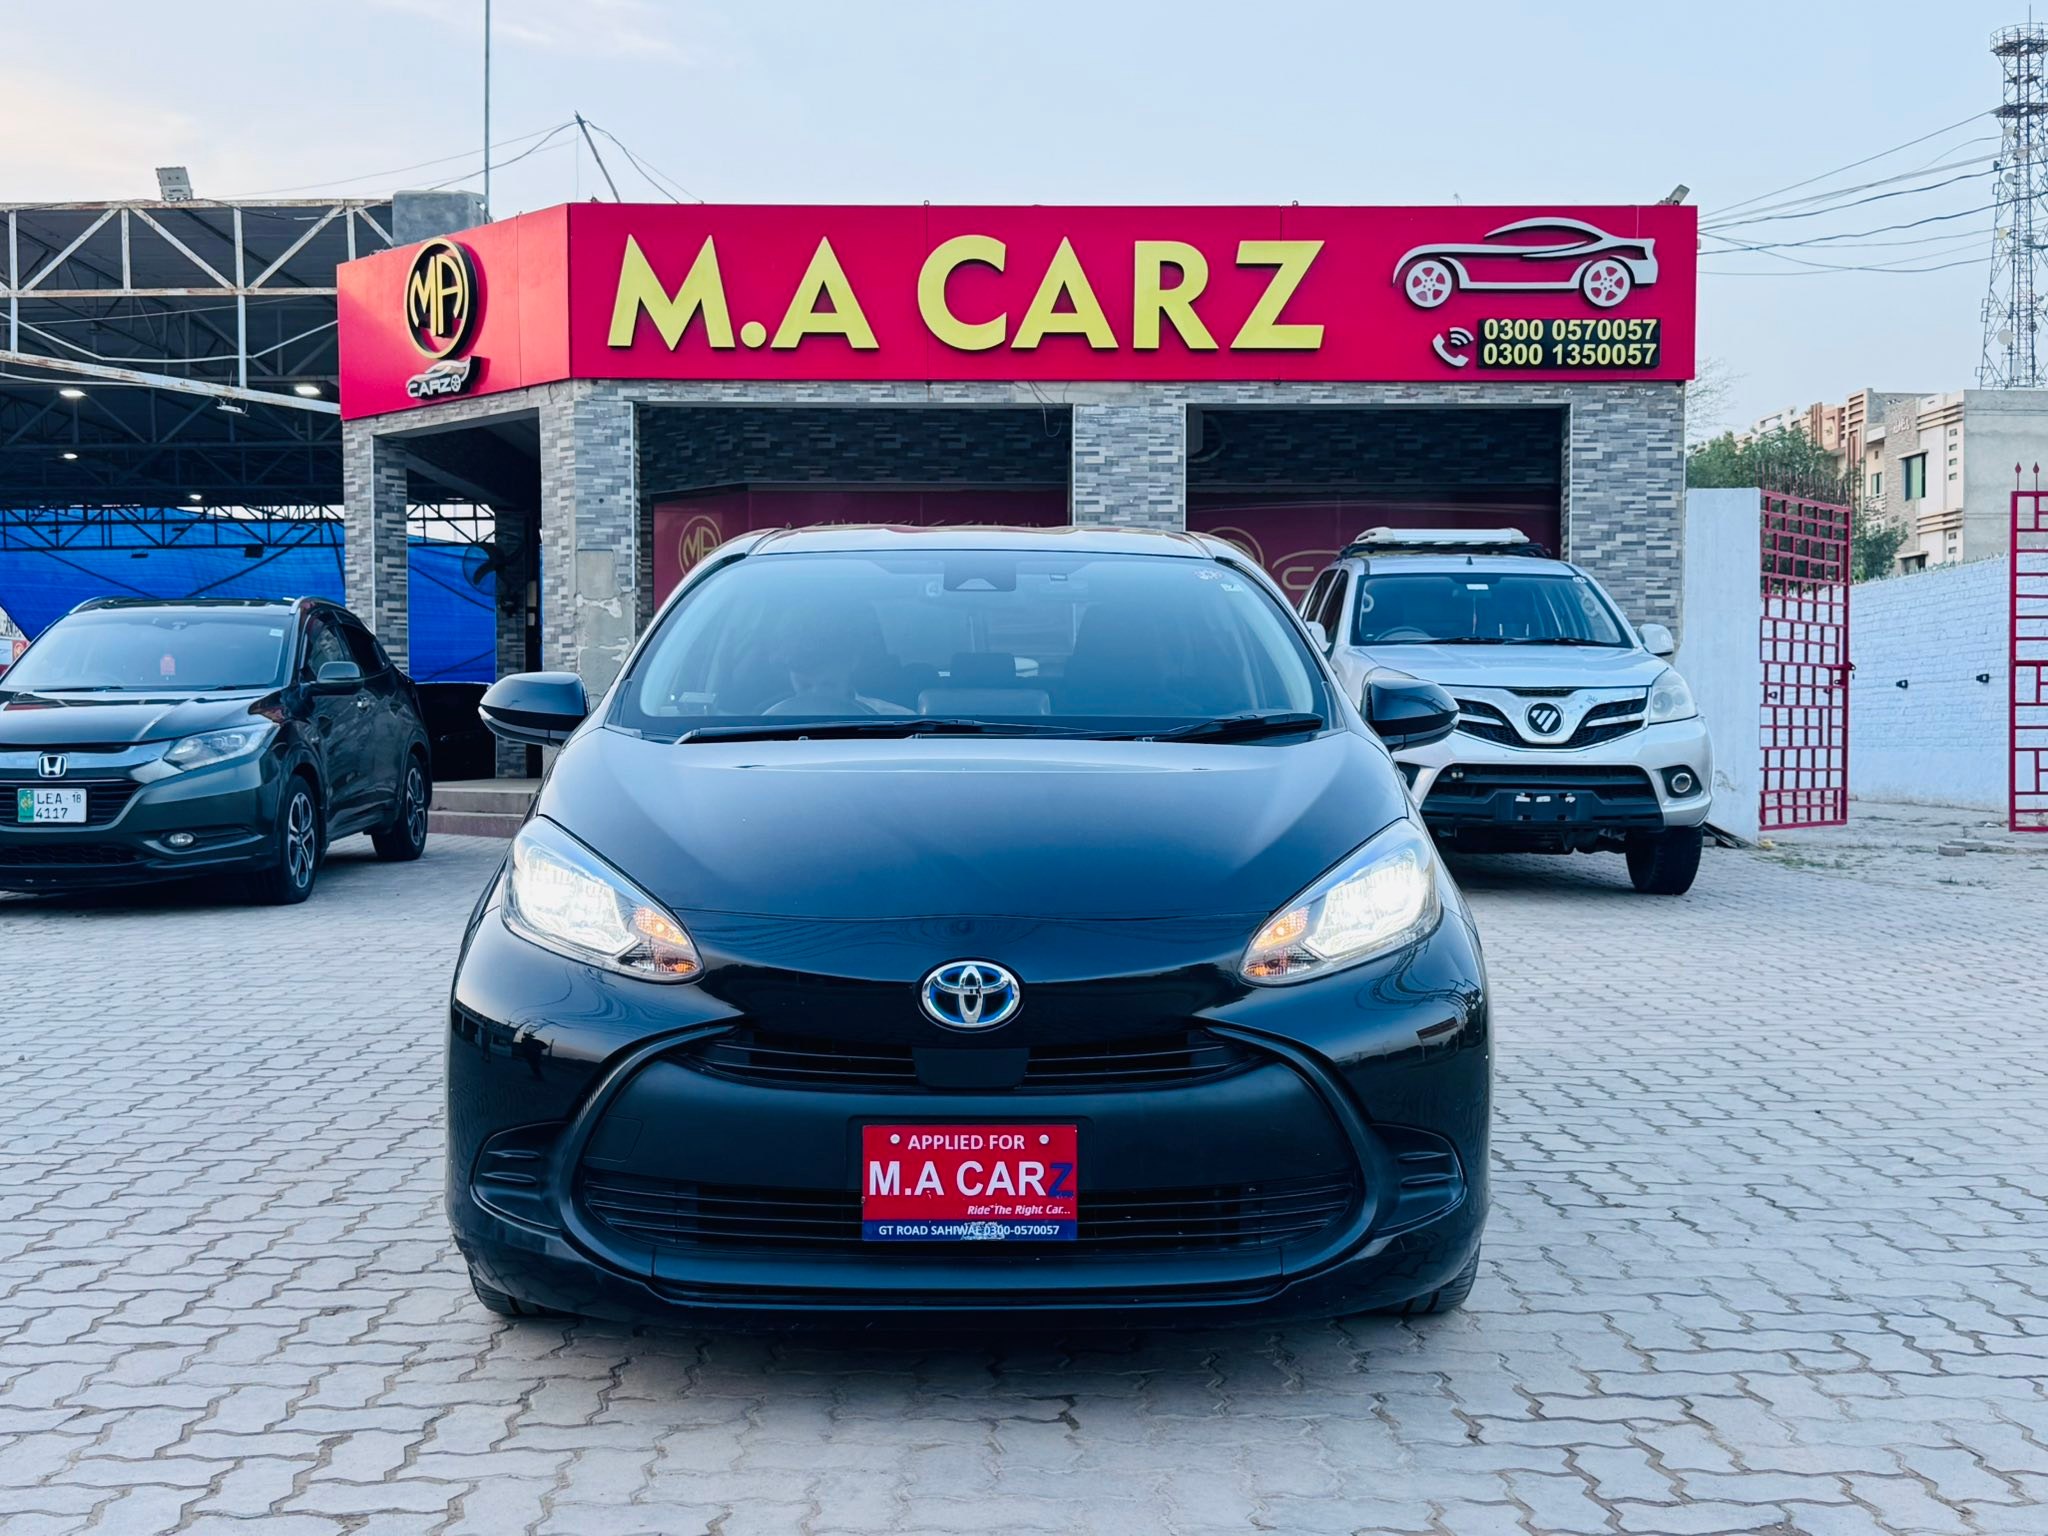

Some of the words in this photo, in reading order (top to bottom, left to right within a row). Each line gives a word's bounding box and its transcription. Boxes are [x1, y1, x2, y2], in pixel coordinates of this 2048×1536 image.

[607, 234, 879, 351] M.A
[917, 234, 1326, 351] CARZ
[1484, 318, 1544, 340] 0300
[1551, 318, 1657, 340] 0570057
[1483, 343, 1543, 365] 0300
[1552, 343, 1657, 365] 1350057
[36, 792, 63, 805] LEA
[35, 807, 69, 820] 4117
[907, 1134, 984, 1151] APPLIED
[988, 1134, 1025, 1150] FOR
[869, 1160, 945, 1197] M.A
[956, 1160, 1074, 1198] CARZ
[967, 1205, 991, 1215] Ride
[994, 1205, 1012, 1215] The
[1014, 1205, 1043, 1217] Right
[879, 1225, 894, 1236] GT
[896, 1225, 928, 1236] ROAD
[984, 1224, 1060, 1236] 0300-0570057
